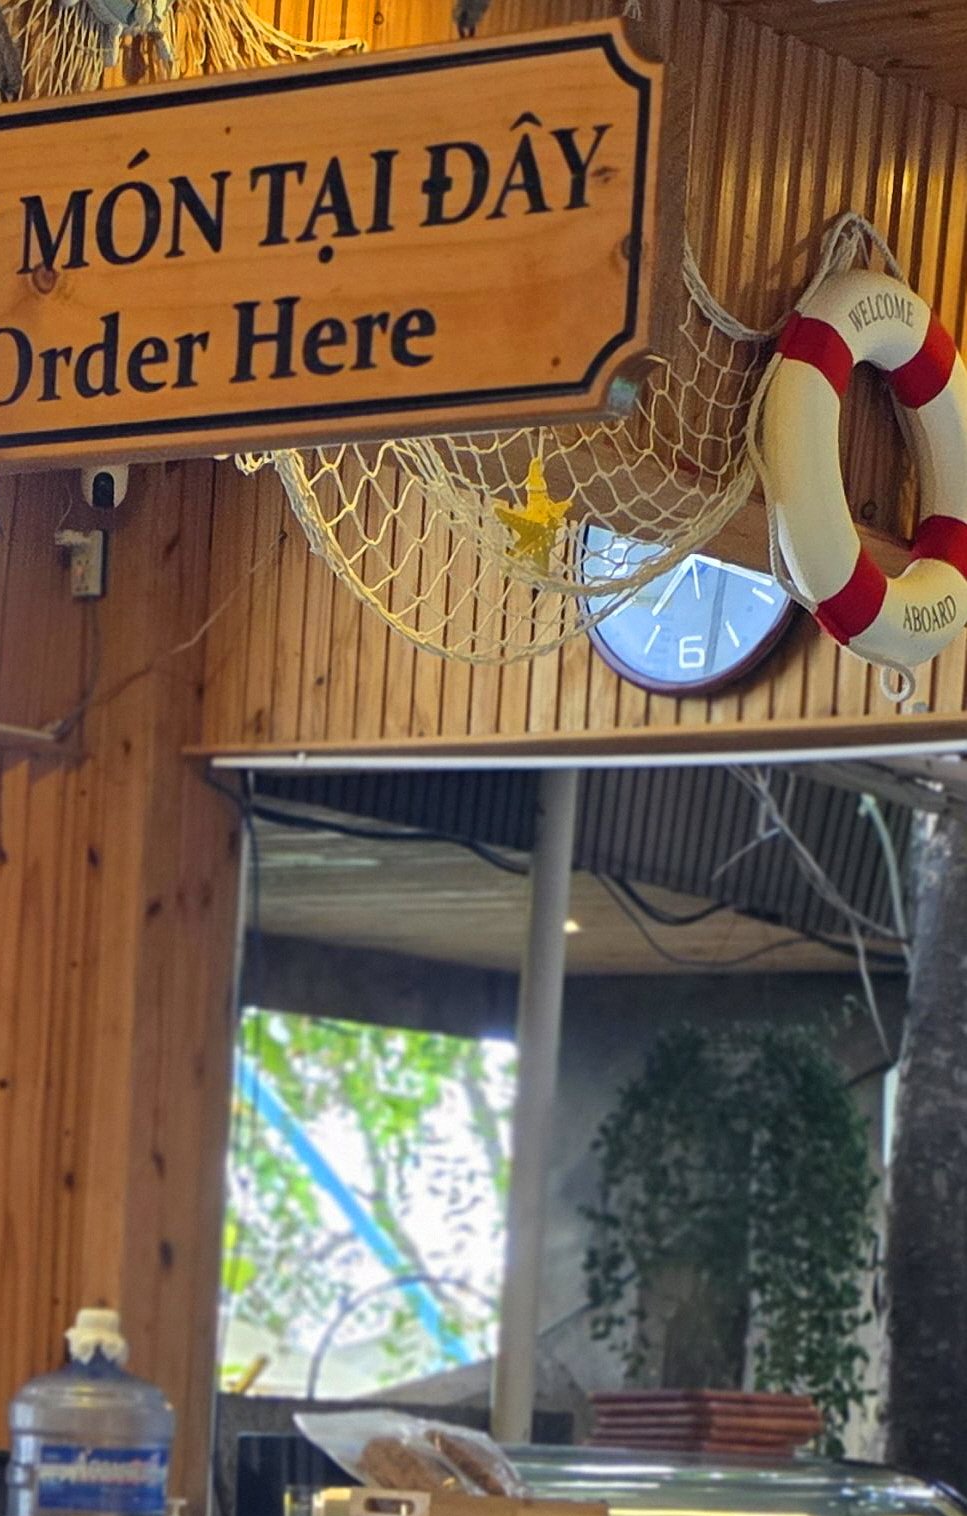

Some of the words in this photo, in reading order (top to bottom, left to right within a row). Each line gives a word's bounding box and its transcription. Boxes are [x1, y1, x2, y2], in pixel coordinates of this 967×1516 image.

[18, 148, 230, 277] MÓN
[249, 150, 399, 264] TẠI
[421, 111, 614, 228] ĐÂY
[848, 292, 914, 333] WELCOME
[230, 296, 437, 385] Here
[903, 594, 957, 632] ABOARD
[679, 635, 706, 669] 6
